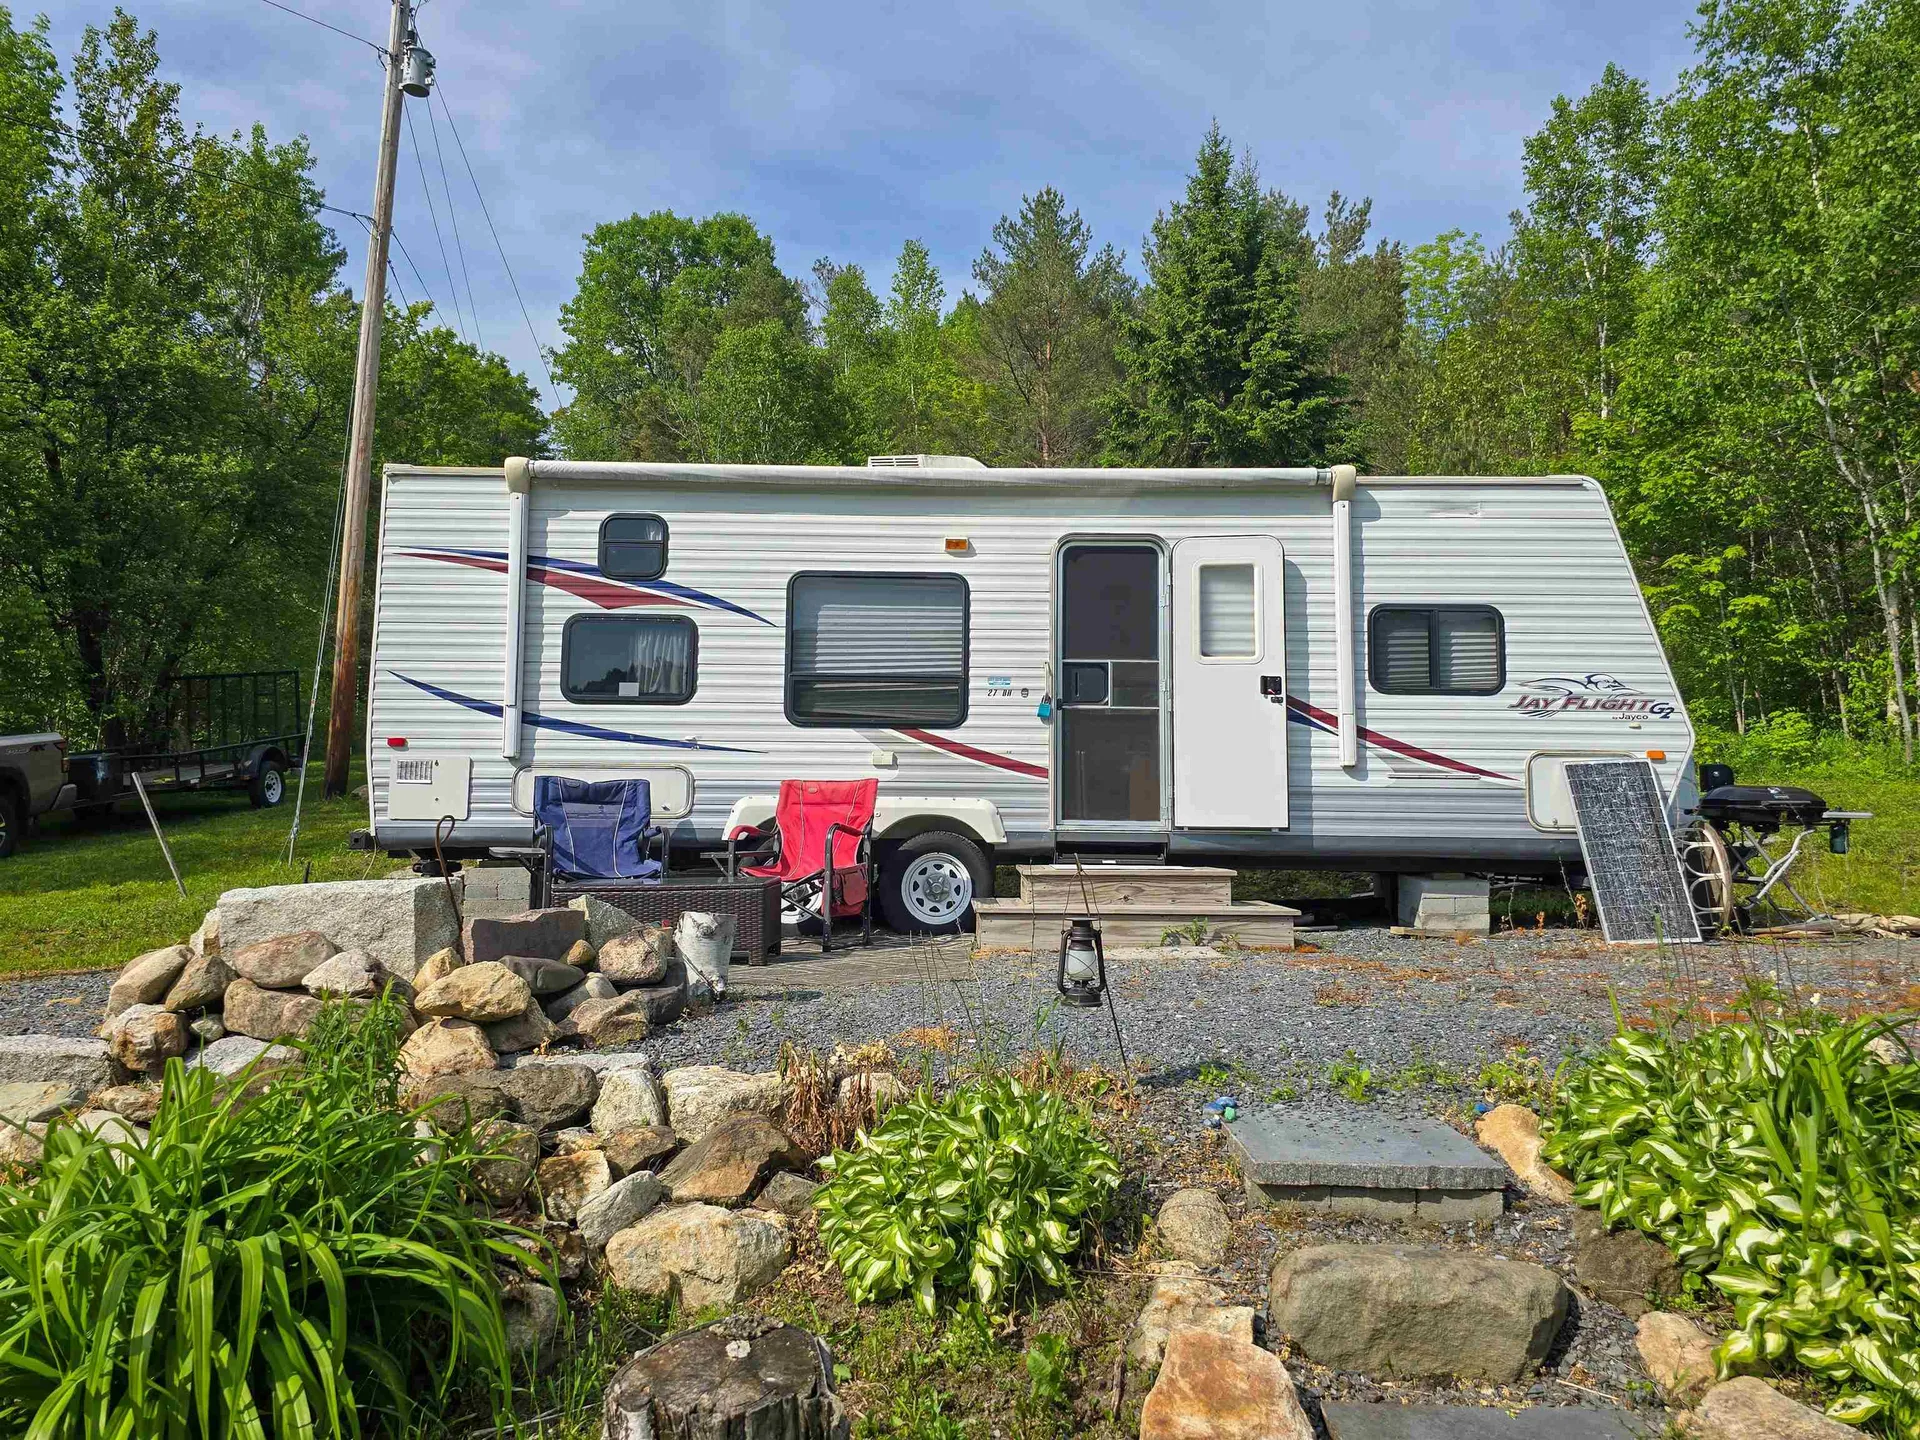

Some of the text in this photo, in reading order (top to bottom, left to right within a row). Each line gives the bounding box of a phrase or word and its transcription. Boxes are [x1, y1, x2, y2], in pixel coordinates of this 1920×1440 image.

[1507, 695, 1675, 719] JAY FLIGHT G2
